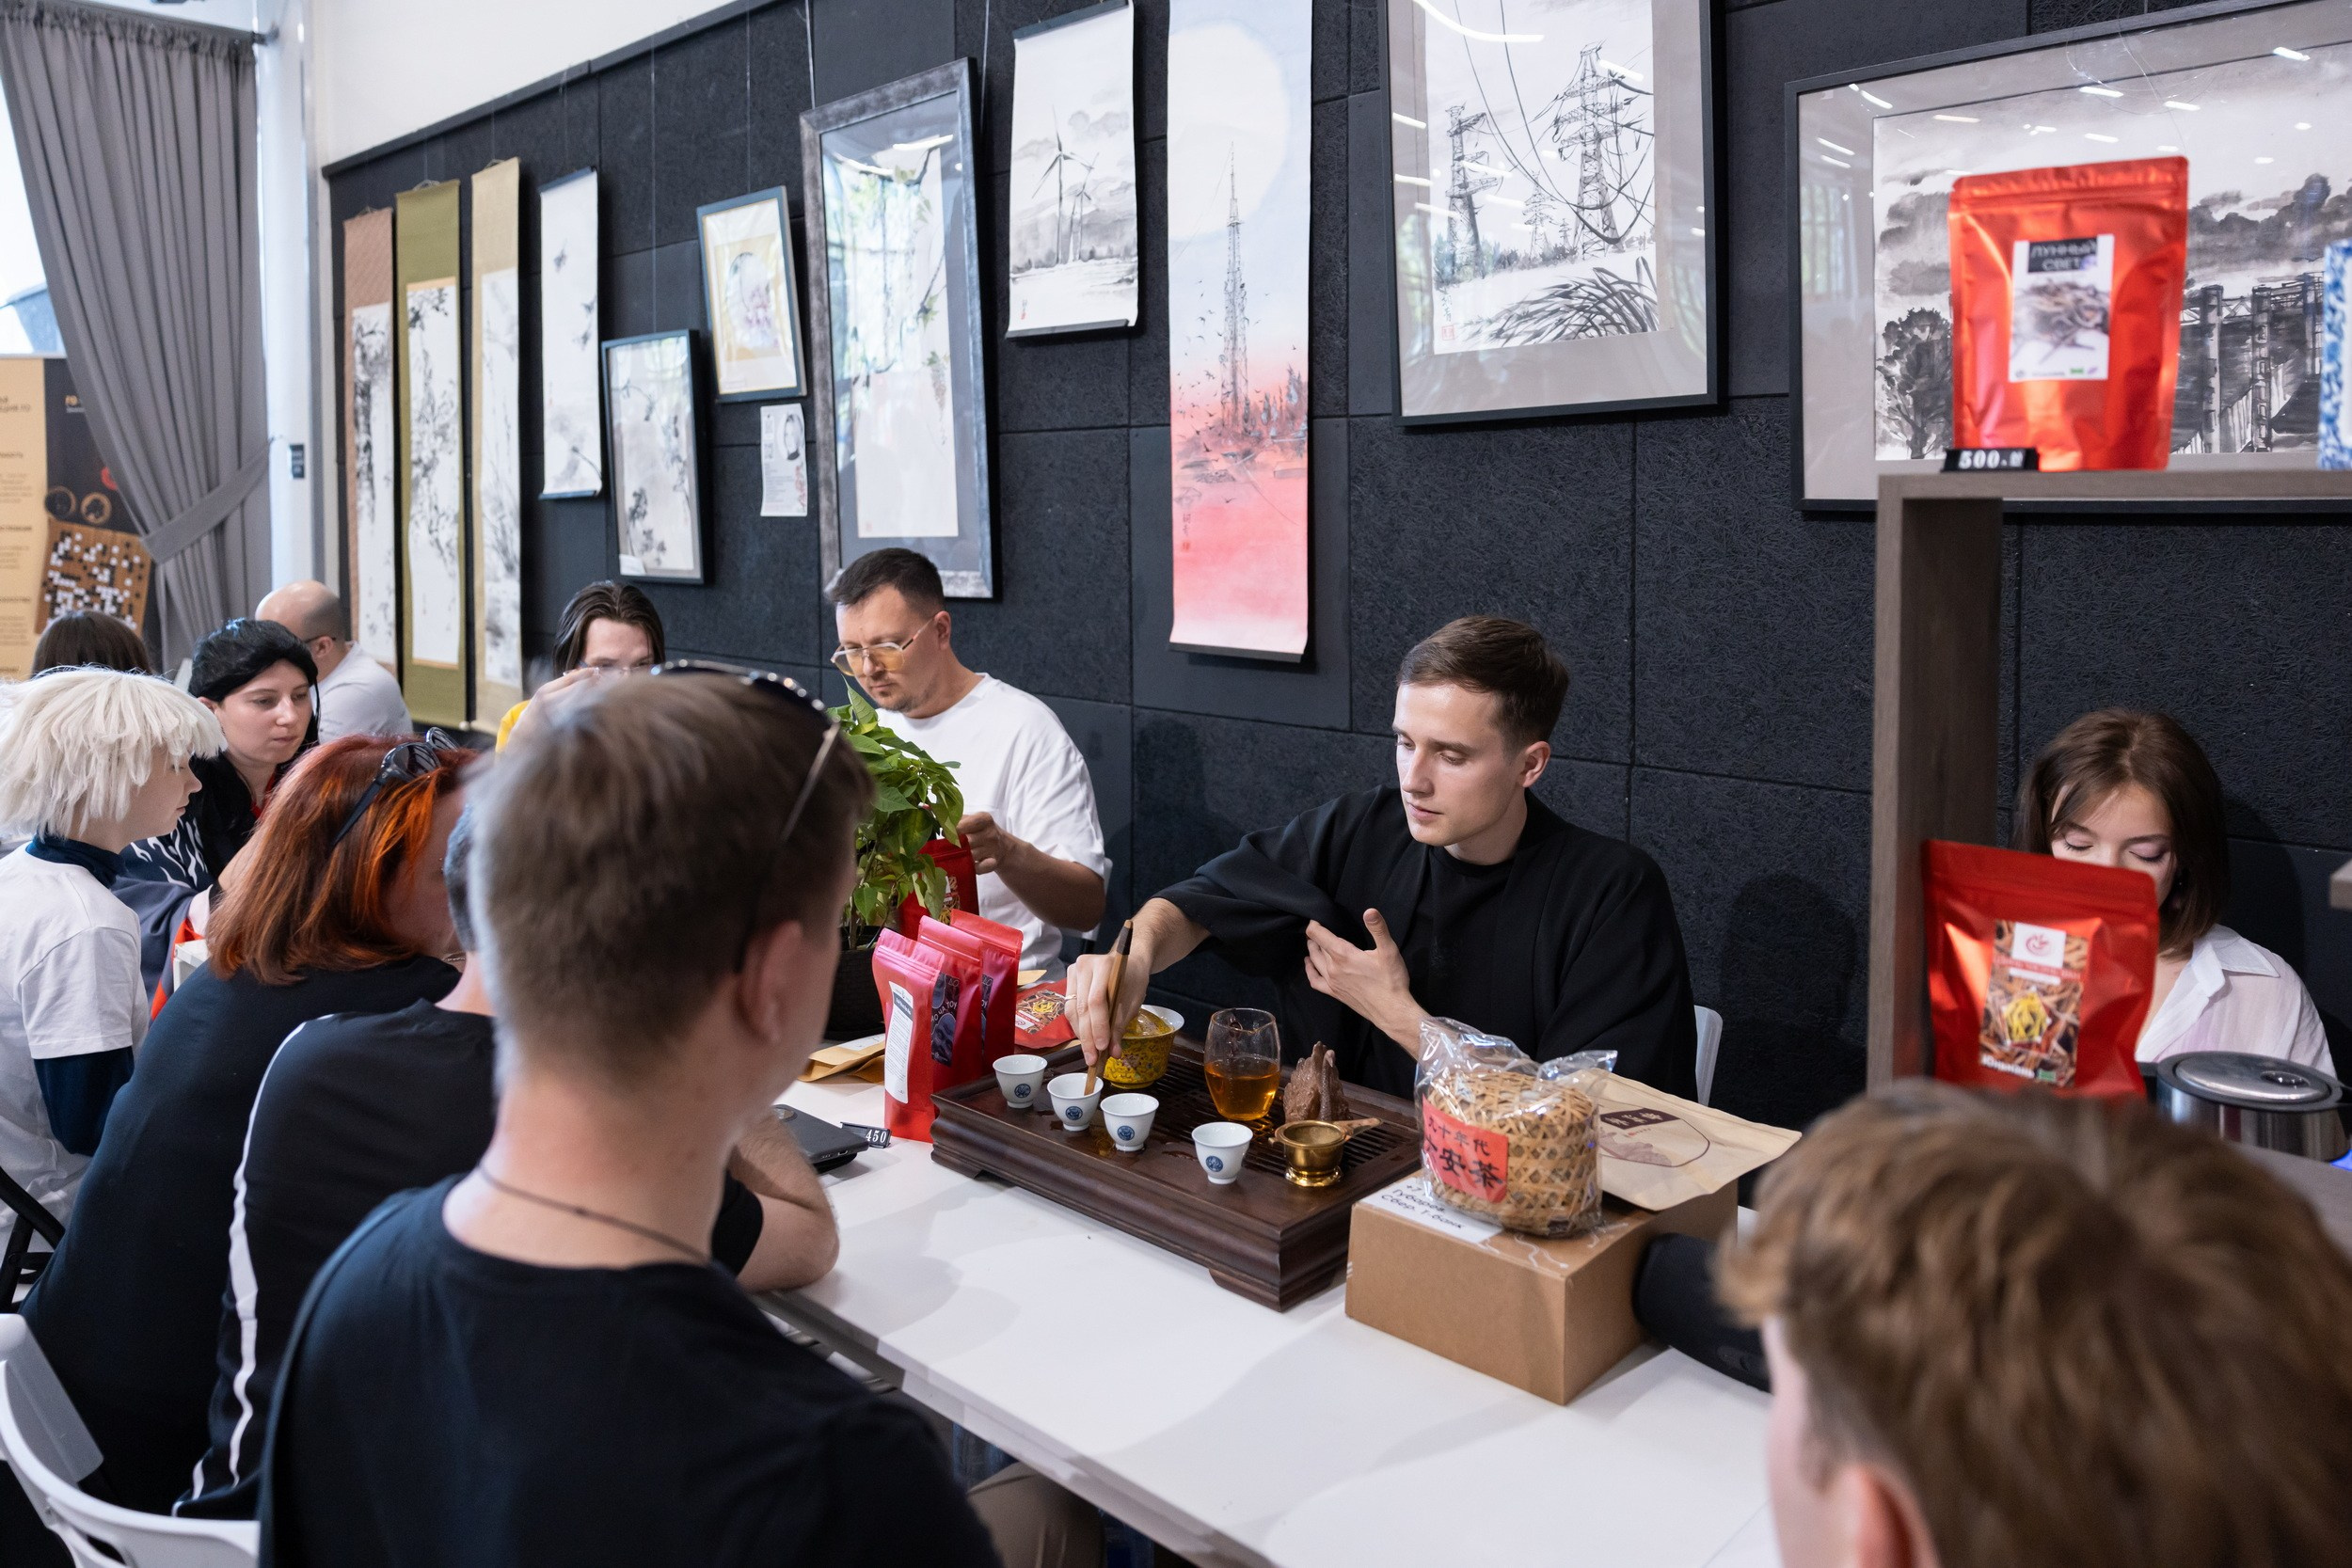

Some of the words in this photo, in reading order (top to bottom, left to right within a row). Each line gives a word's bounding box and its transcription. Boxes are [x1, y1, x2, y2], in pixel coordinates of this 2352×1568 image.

[866, 1129, 887, 1144] 450
[1428, 1116, 1490, 1156] 九十年代
